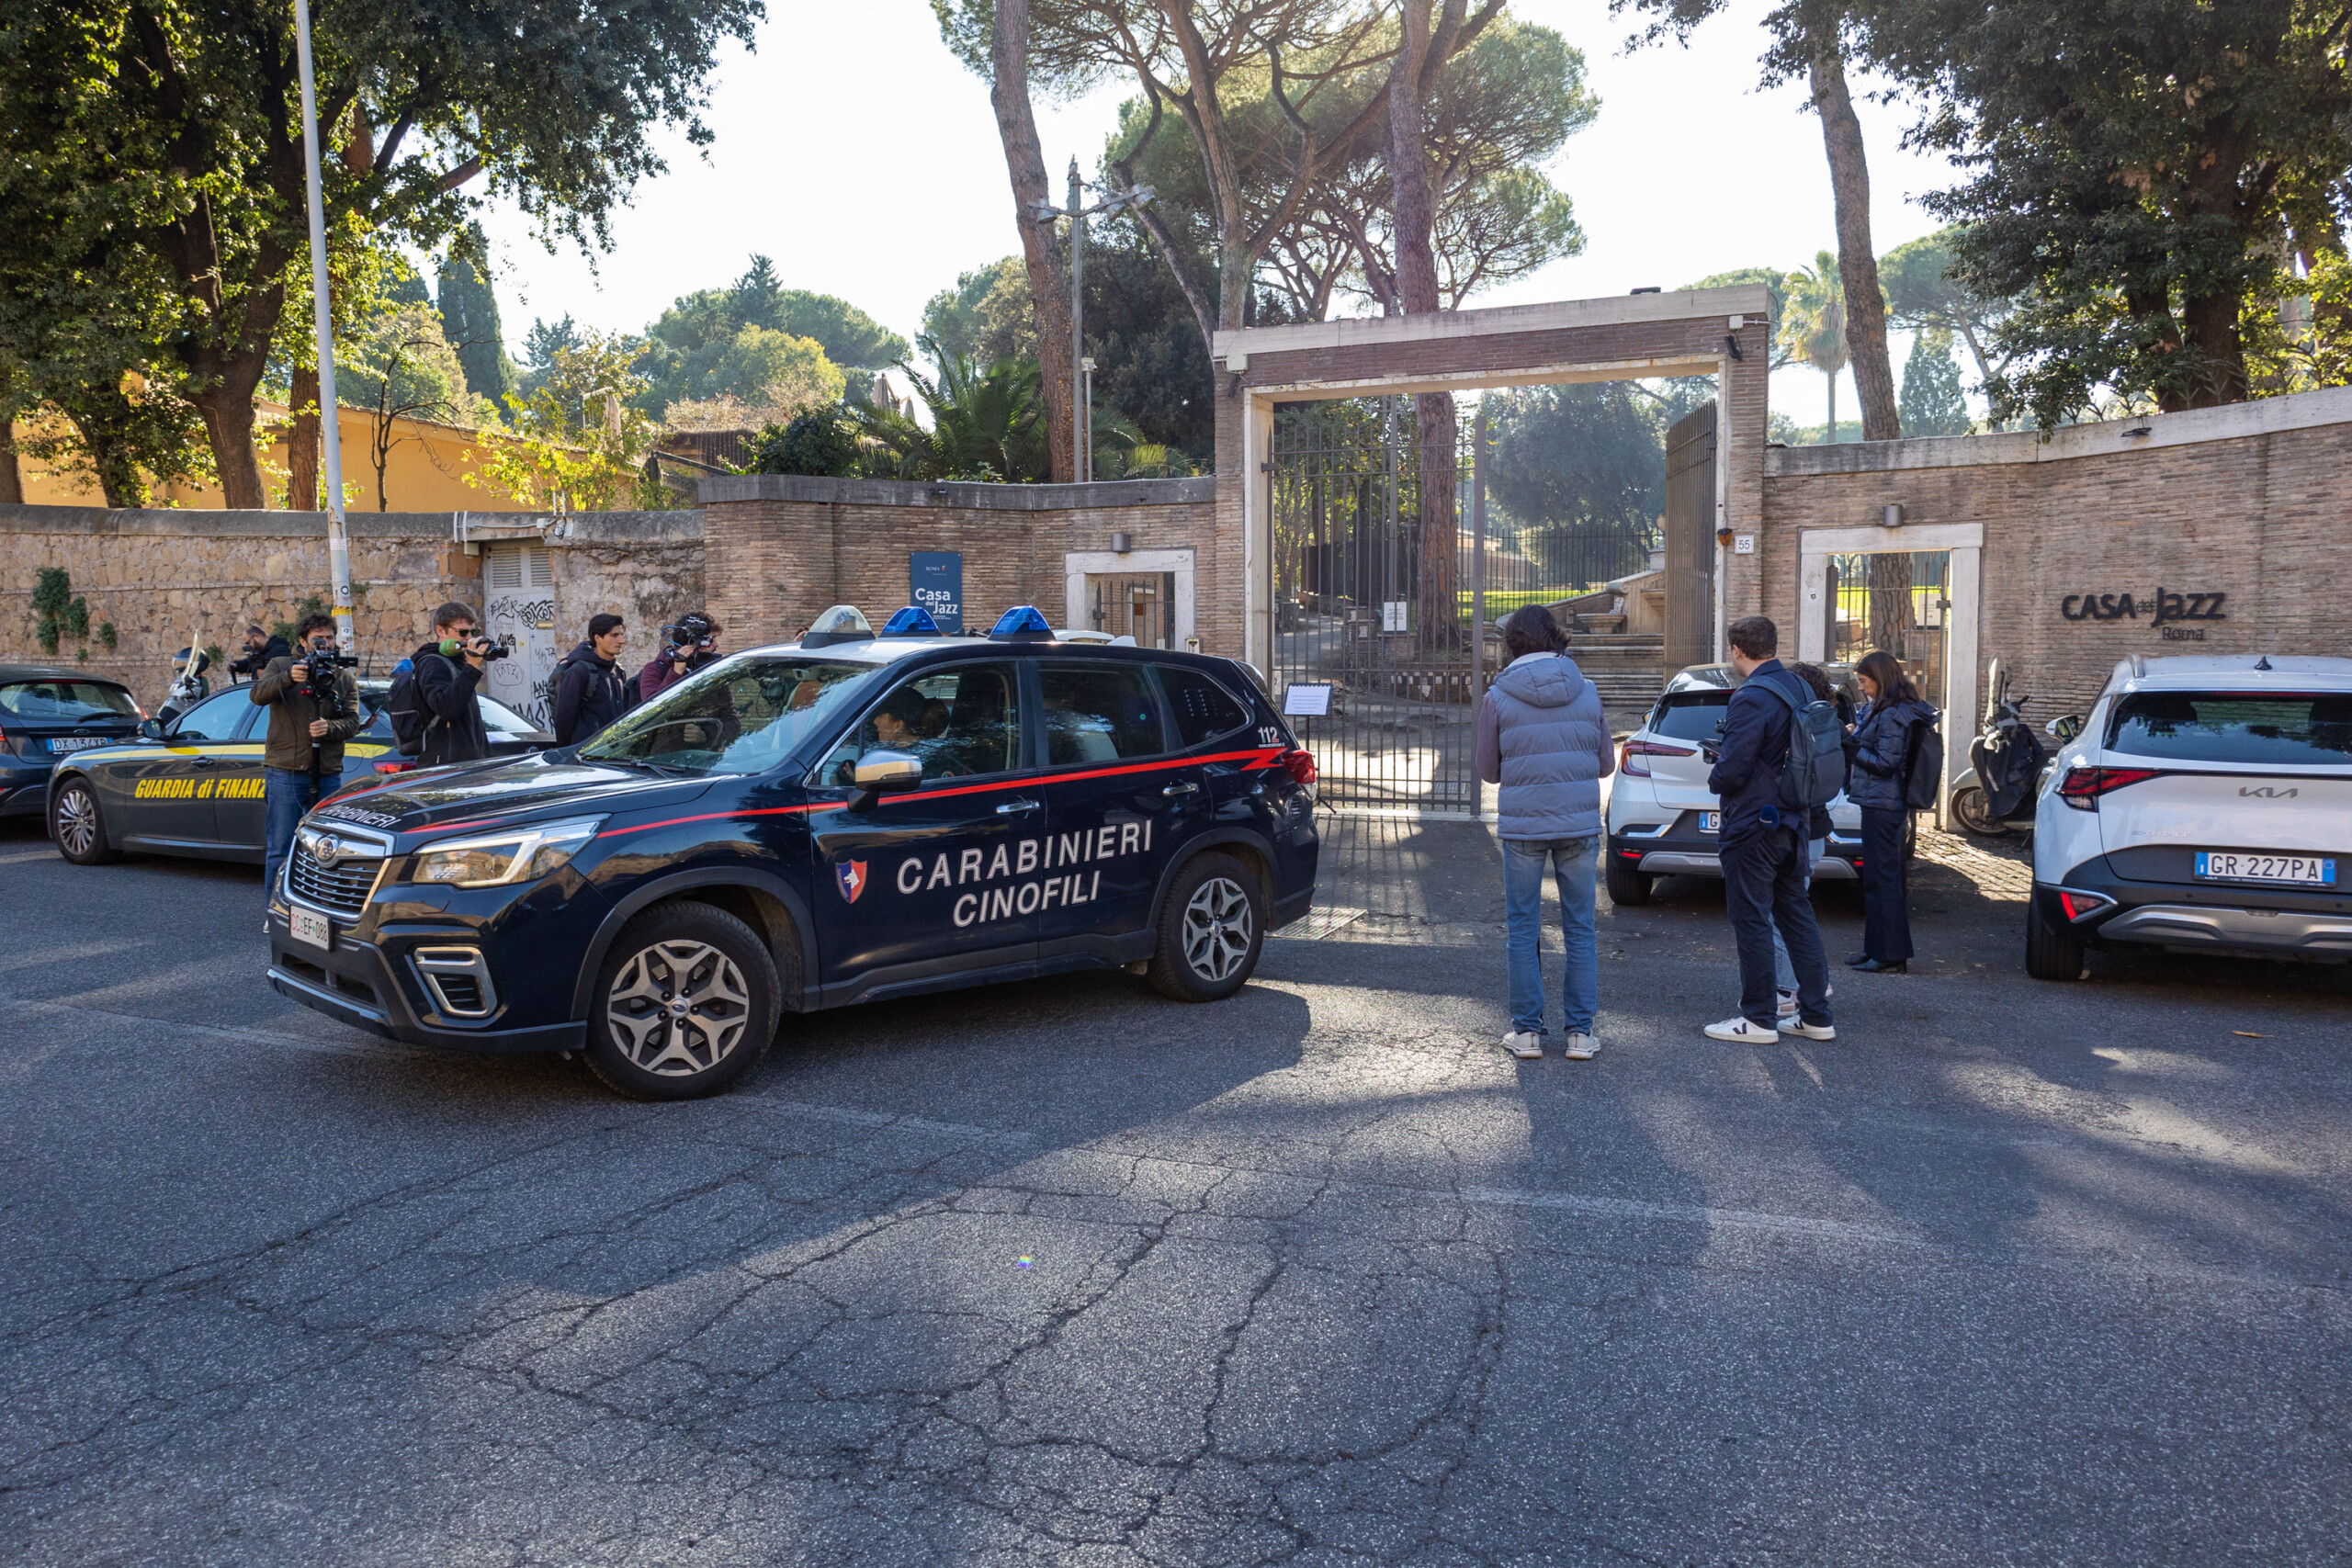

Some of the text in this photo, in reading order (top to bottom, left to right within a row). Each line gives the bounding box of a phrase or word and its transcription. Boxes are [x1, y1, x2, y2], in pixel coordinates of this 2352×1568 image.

[1738, 539, 1750, 549] 55
[915, 588, 951, 601] Casa
[933, 602, 958, 615] Jazz
[2062, 593, 2136, 620] CASA
[2151, 587, 2227, 627] Jazz
[2162, 627, 2204, 641] Roma
[1258, 727, 1279, 743] 112
[55, 739, 68, 750] DX
[134, 779, 266, 798] GUARDIA di FINANZ
[1710, 814, 1718, 828] G
[897, 819, 1152, 895] CARABINIERI
[2211, 855, 2236, 875] GR
[2247, 857, 2319, 880] 227PA
[953, 870, 1101, 928] CINOFILI
[304, 917, 312, 936] EF
